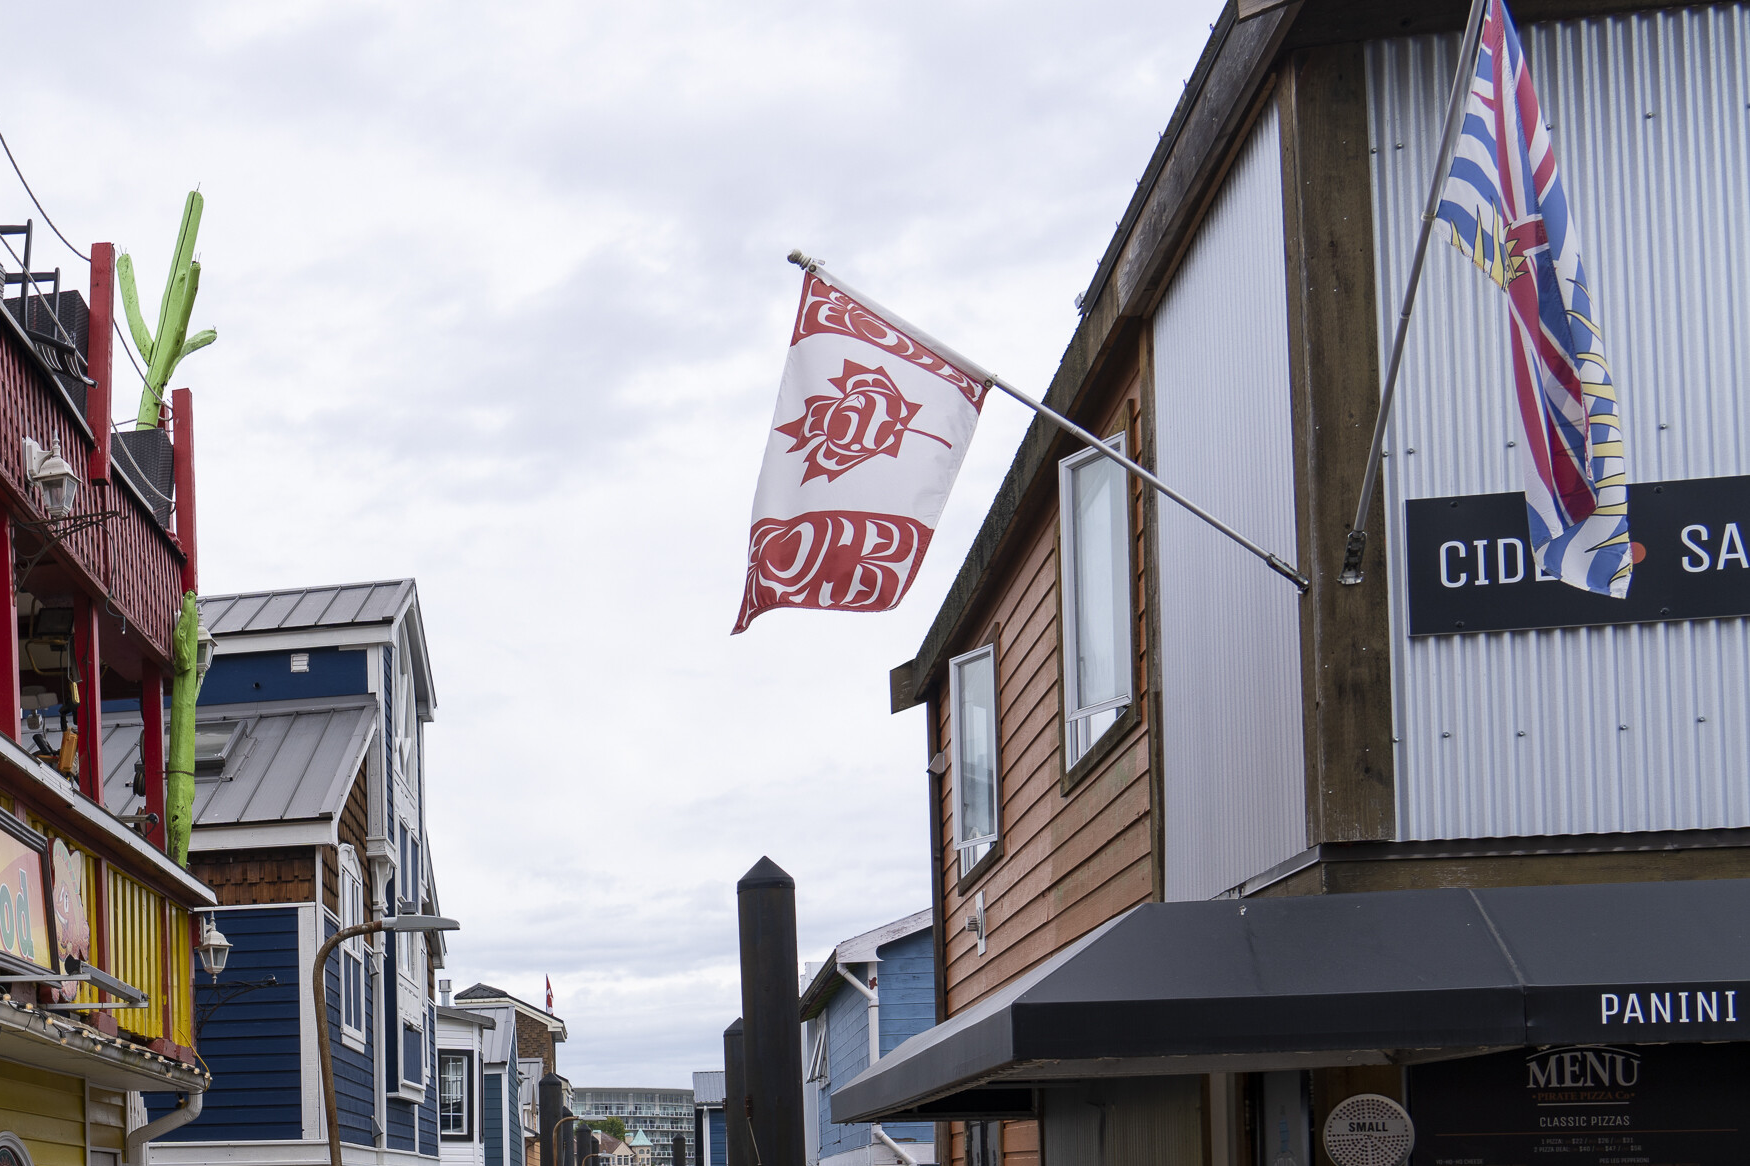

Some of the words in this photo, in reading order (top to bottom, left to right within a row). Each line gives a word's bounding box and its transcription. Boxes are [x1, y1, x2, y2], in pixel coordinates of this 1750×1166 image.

[1439, 538, 1562, 588] CID
[1601, 990, 1738, 1026] PANINI
[1525, 1050, 1641, 1089] MENU
[1537, 1091, 1578, 1102] PIRATE
[1579, 1090, 1613, 1101] PIZZA
[1348, 1121, 1389, 1134] SMALL
[1539, 1116, 1588, 1128] CLASSIC
[1590, 1115, 1631, 1127] PIZZAS
